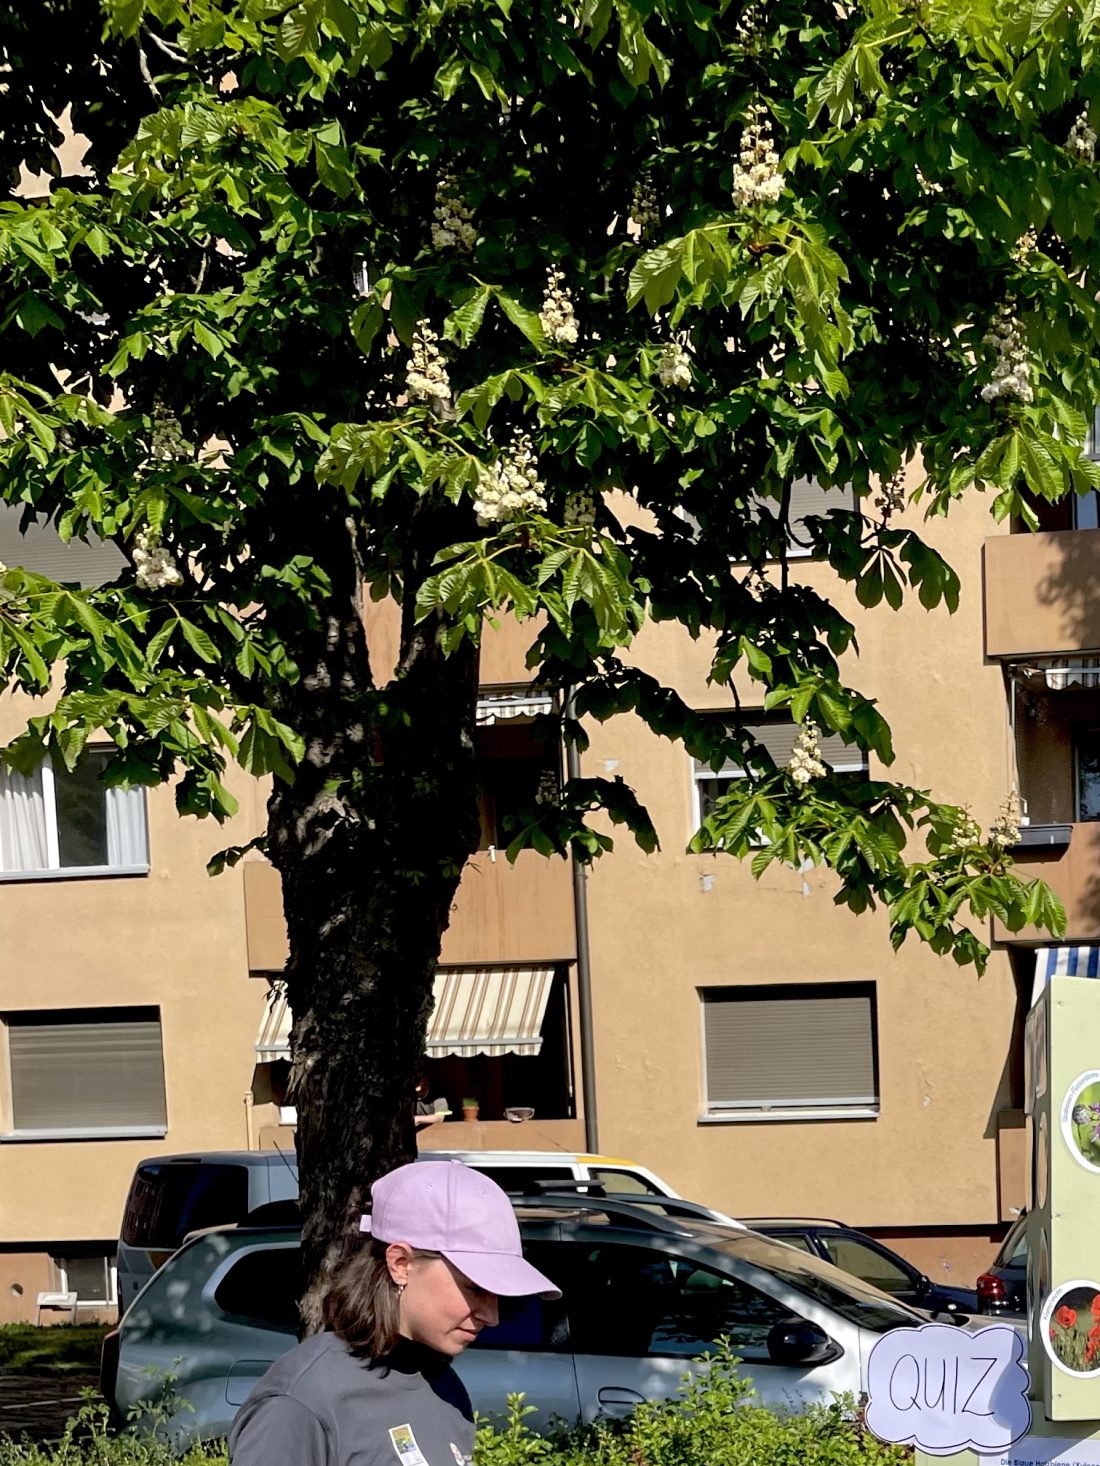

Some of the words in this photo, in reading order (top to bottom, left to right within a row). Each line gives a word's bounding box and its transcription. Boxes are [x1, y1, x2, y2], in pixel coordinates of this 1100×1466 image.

[889, 1353, 998, 1417] QUIZ
[1000, 1458, 1012, 1466] Die
[1013, 1459, 1034, 1466] Blaue
